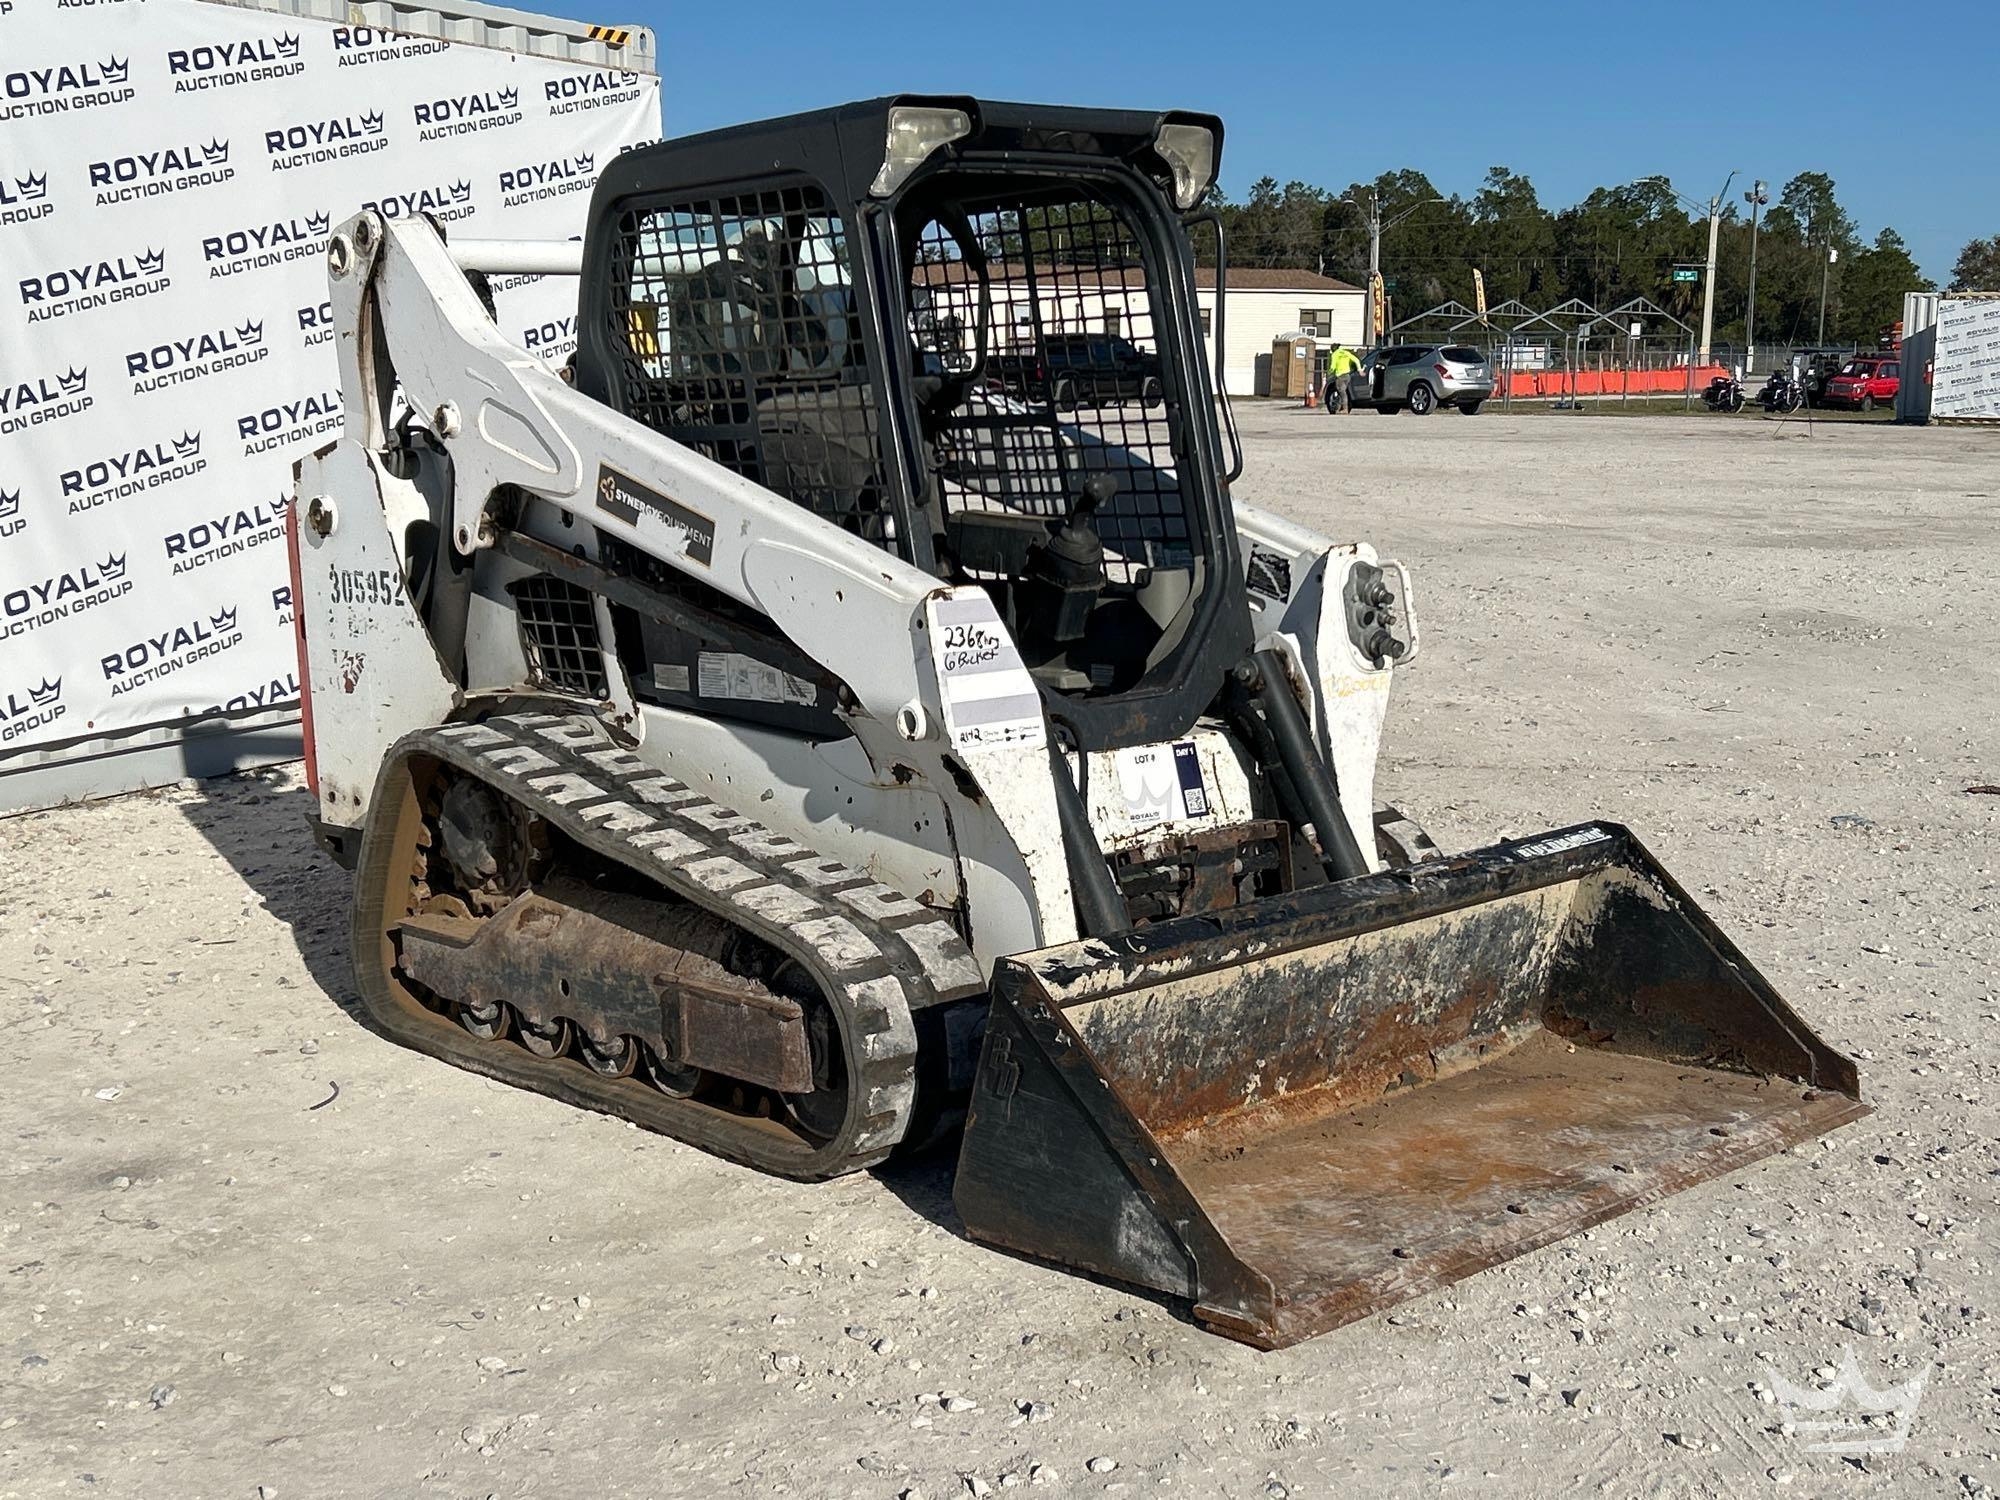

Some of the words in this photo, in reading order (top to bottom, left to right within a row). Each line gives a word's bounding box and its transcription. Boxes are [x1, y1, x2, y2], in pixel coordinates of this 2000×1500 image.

[332, 26, 421, 50] ROY
[338, 48, 400, 68] AUCTION
[403, 42, 451, 58] GROUP
[167, 39, 276, 75] ROYAL
[0, 64, 100, 100] OYAL
[174, 69, 248, 93] AUCTION
[251, 62, 305, 82] GROUP
[544, 71, 621, 101] ROYAL
[0, 98, 69, 121] UCTION
[71, 88, 136, 109] GROUP
[413, 92, 500, 126] ROYAL
[549, 98, 601, 117] AUCTION
[603, 89, 642, 106] GROUP
[264, 117, 362, 154] ROYAL
[419, 120, 477, 142] AUCTION
[479, 112, 523, 131] GROUP
[88, 146, 203, 188] ROYAL
[271, 148, 337, 172] AUCTION
[339, 138, 389, 158] GROUP
[95, 179, 174, 207] AUCTION
[175, 168, 236, 191] GROUP
[499, 158, 576, 193] ROYAL
[0, 203, 55, 227] ROUP
[503, 186, 557, 209] AUCTION
[202, 219, 308, 262] ROYAL
[209, 251, 283, 279] AUCTION
[285, 239, 329, 261] GROU
[19, 258, 138, 305] ROYAL
[27, 292, 108, 325] AUCTION
[110, 277, 172, 303] GROUP
[523, 315, 578, 349] ROY
[125, 330, 238, 377] ROYAL
[133, 365, 210, 396] AUCTION
[211, 347, 270, 373] GROUP
[0, 379, 60, 415] YAL
[30, 396, 95, 426] GROUP
[237, 393, 338, 440] ROYAL
[244, 425, 313, 457] AUCTION
[314, 414, 345, 434] GRO
[59, 443, 175, 498] ROYAL
[68, 479, 145, 516] AUCTION
[147, 459, 208, 489] GROUP
[164, 505, 272, 559] ROYAL
[172, 542, 244, 577] AUCTION
[246, 525, 289, 549] GROU
[0, 567, 101, 620] OYAL
[329, 564, 405, 607] 305952
[0, 603, 70, 642] UCTION
[71, 580, 134, 614] GROUP
[100, 620, 213, 681] ROYAL
[111, 656, 185, 699] AUCTION
[186, 632, 244, 666] GROUP
[2, 705, 67, 742] GROUP
[1134, 754, 1150, 765] LOT
